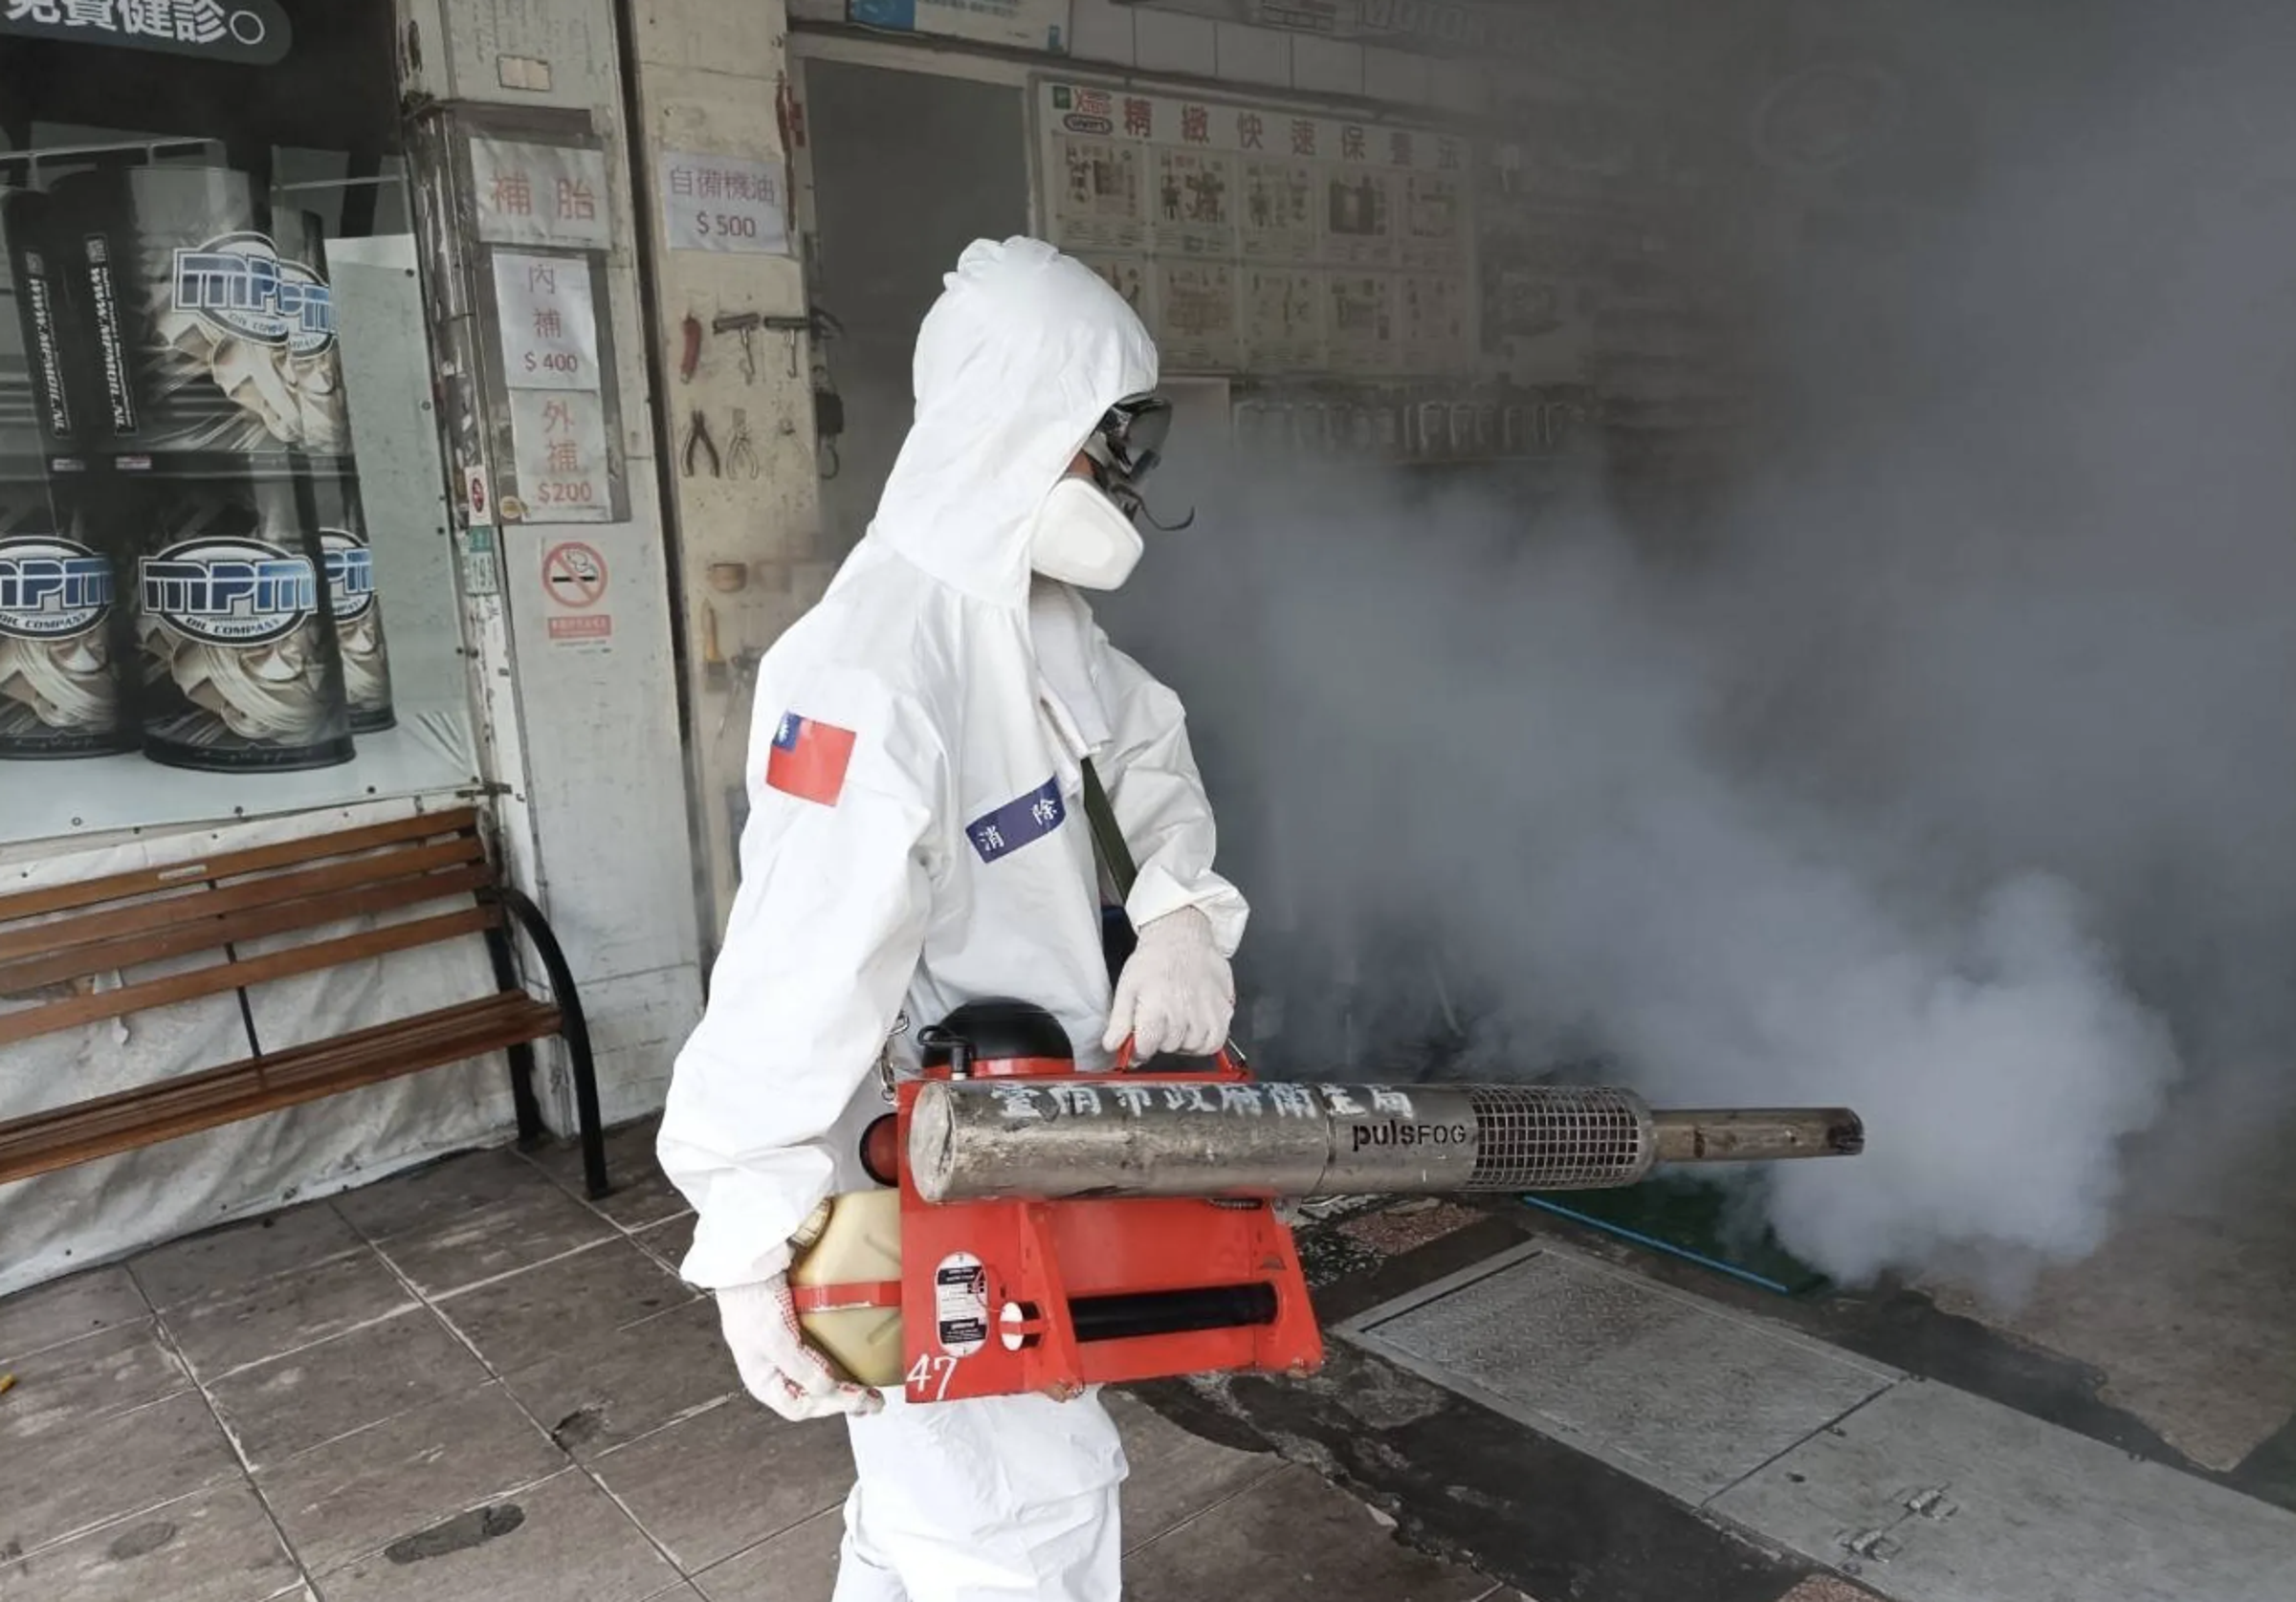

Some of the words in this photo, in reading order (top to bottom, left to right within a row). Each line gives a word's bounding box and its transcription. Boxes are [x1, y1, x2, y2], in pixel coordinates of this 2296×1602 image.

[490, 173, 596, 221] 補胎
[671, 165, 775, 207] 自備機油
[25, 610, 87, 628] COMPANY
[213, 617, 280, 635] COMPANY
[905, 1353, 958, 1400] 47
